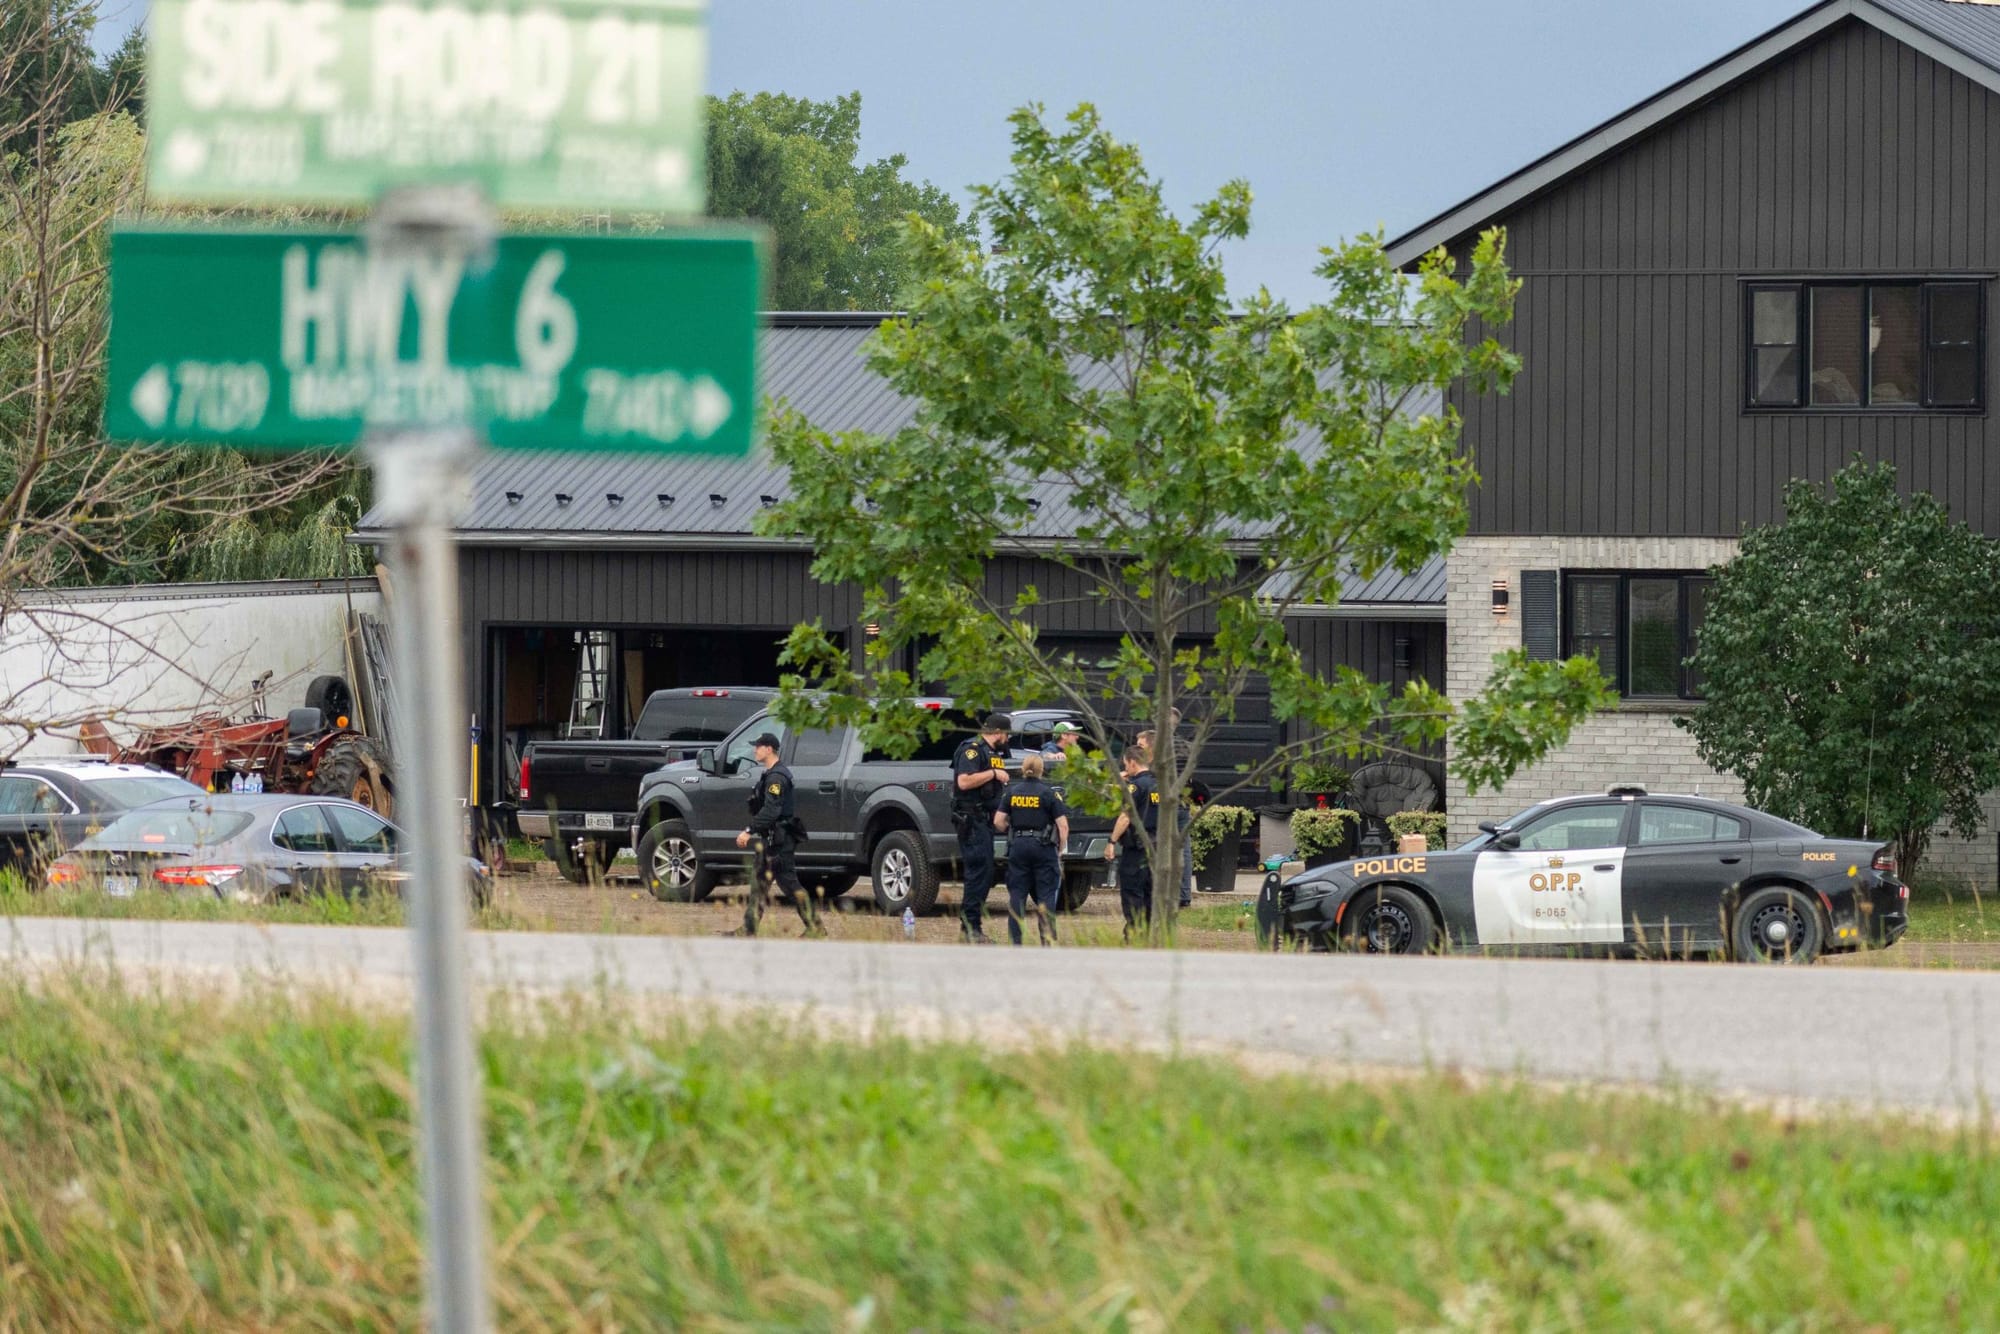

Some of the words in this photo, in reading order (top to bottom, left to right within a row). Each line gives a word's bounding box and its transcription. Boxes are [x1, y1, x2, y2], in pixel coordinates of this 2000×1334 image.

[181, 0, 344, 112] SIDE
[370, 1, 572, 120] ROAD
[586, 16, 659, 125] 21
[281, 243, 466, 366] HWY
[515, 248, 577, 372] 6
[1011, 796, 1040, 808] POLICE
[1803, 852, 1836, 861] POLICE
[1353, 857, 1427, 878] POLICE
[1529, 873, 1583, 892] O.P.P.
[1535, 907, 1567, 918] 6-065
